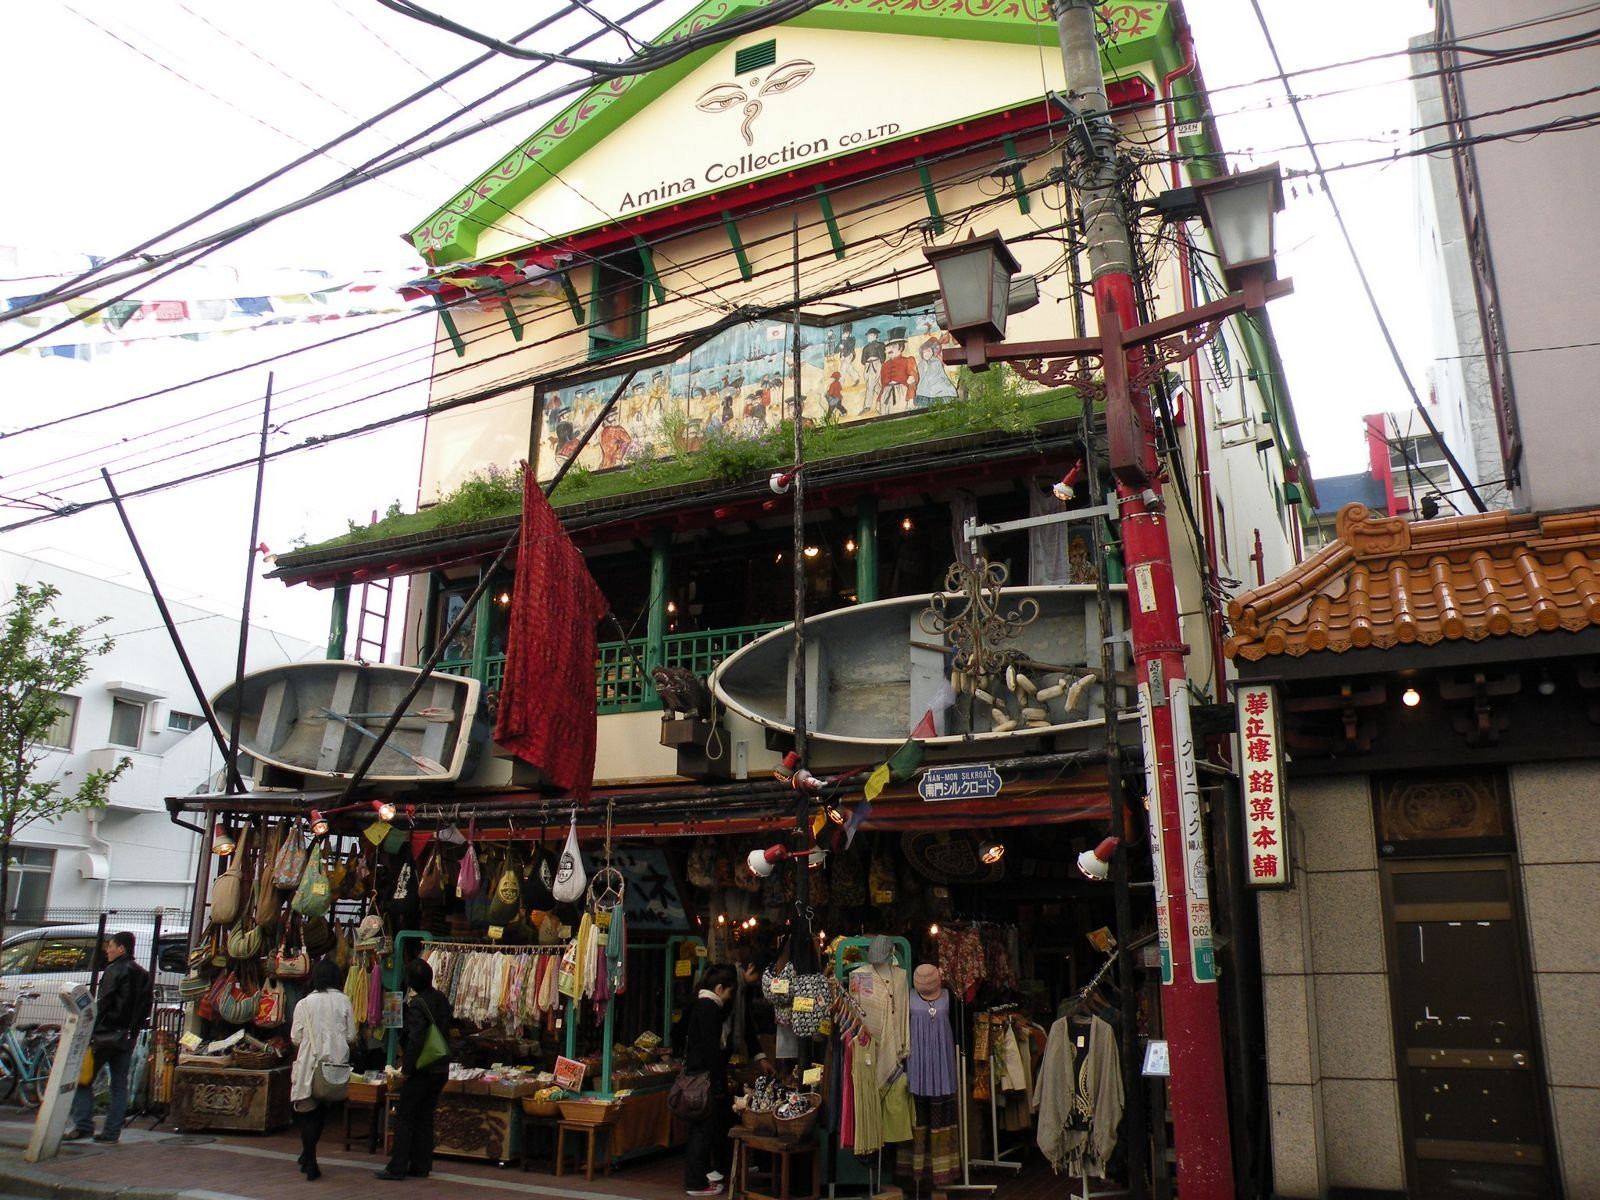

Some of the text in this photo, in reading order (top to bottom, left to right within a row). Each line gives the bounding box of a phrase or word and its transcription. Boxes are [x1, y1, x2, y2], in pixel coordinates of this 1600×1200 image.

[618, 176, 696, 212] Amina
[704, 137, 829, 184] Collection
[927, 770, 992, 782] NAN-MON SILKROAD
[925, 779, 995, 797] 南門シルクロード
